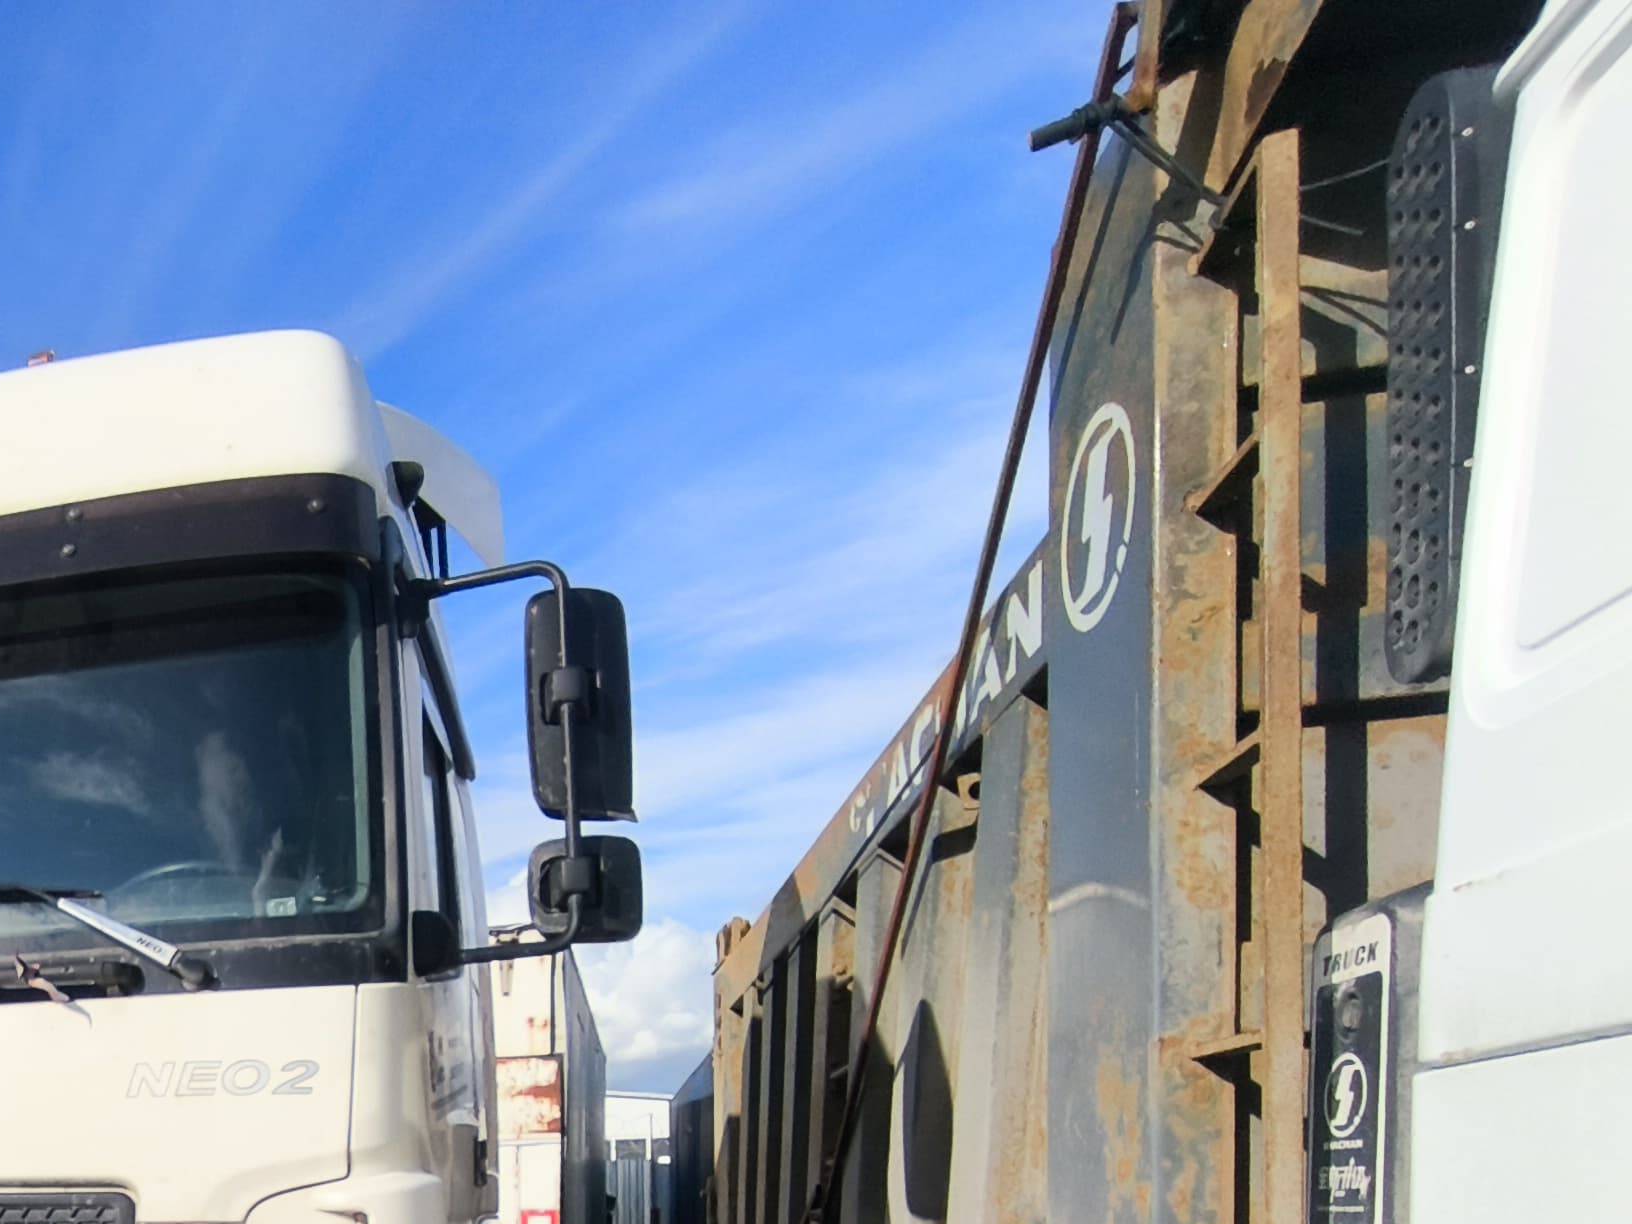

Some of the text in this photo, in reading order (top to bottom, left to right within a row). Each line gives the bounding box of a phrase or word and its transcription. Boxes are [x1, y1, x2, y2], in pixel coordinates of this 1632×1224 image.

[849, 559, 1043, 838] ACAN
[1323, 941, 1379, 977] TRUCK
[126, 1058, 321, 1099] NEO2
